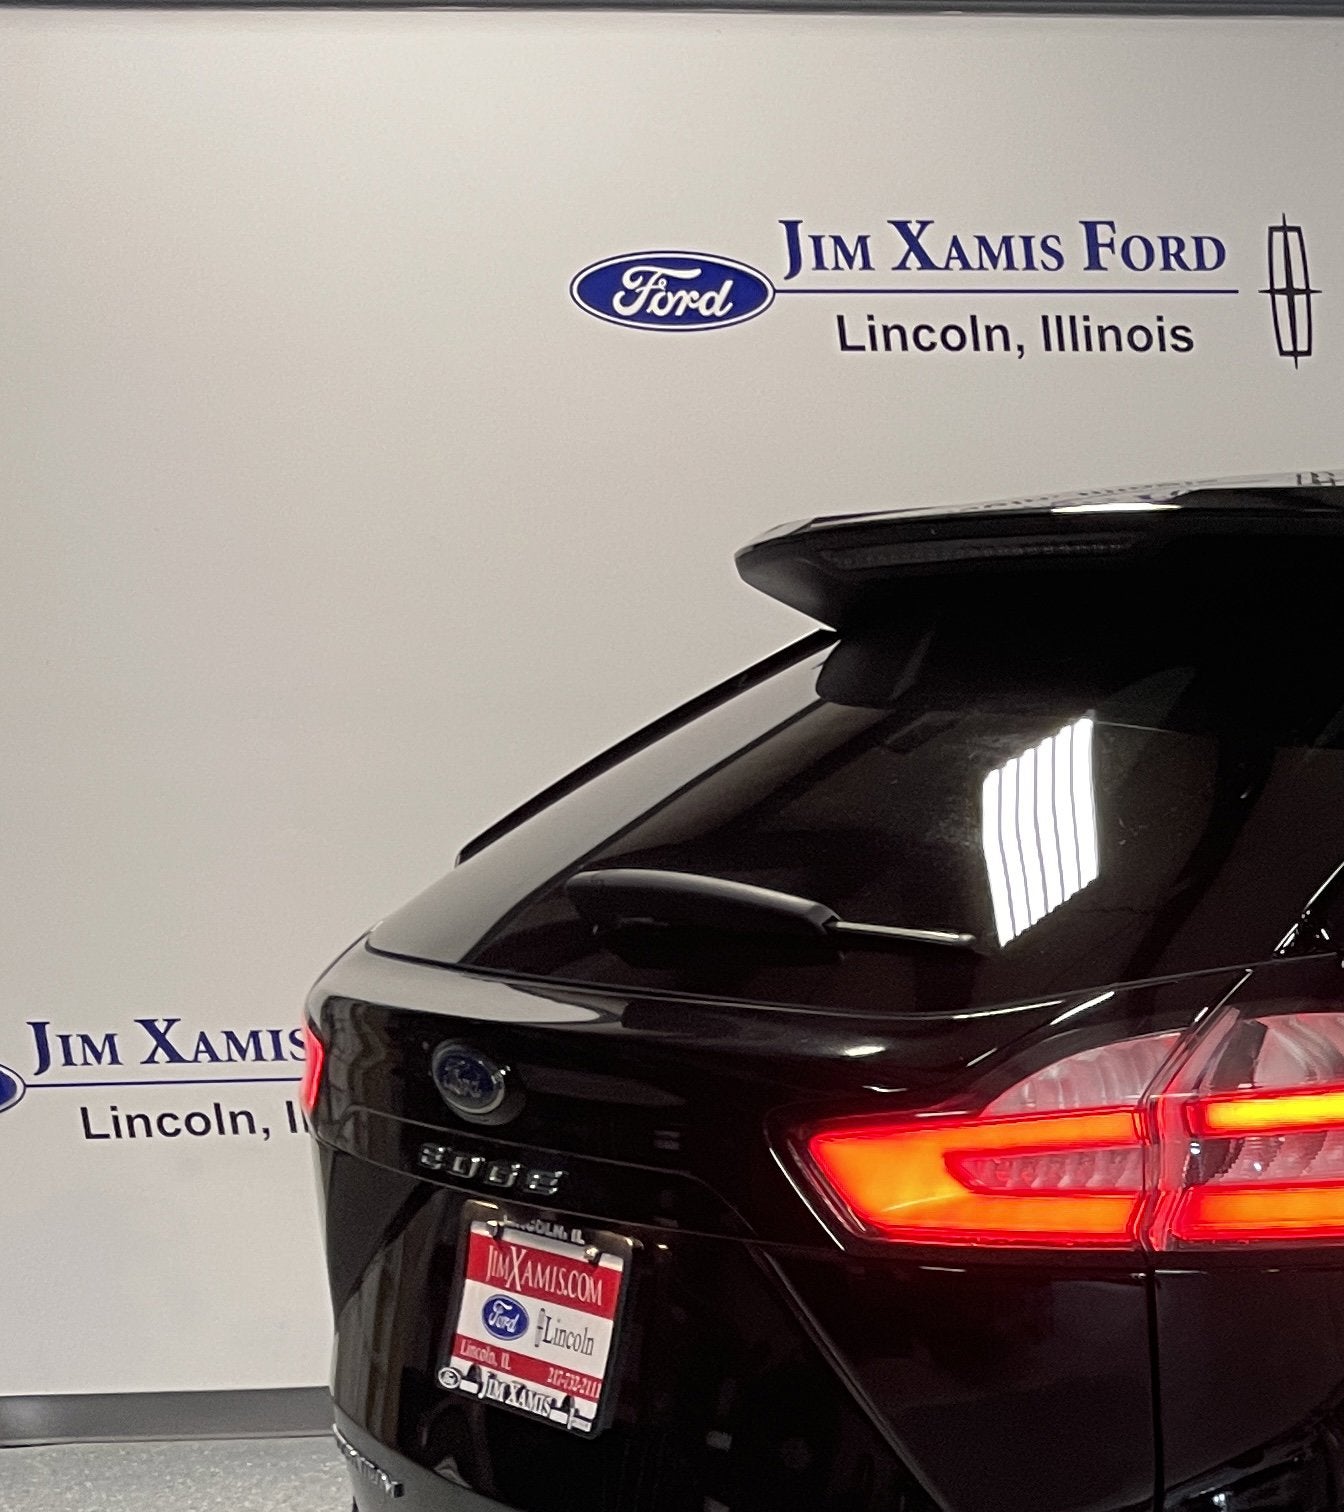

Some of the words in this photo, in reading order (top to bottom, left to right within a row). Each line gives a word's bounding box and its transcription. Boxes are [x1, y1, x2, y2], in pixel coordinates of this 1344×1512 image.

[778, 219, 873, 280] JIM
[887, 219, 1064, 271] XAMIS
[1079, 220, 1226, 271] FORD
[612, 266, 733, 317] Ford
[836, 313, 1025, 360] Lincoln,
[1042, 313, 1194, 353] Illinois
[26, 1021, 124, 1076] JIM
[80, 1102, 271, 1141] Lincoln,
[488, 1300, 522, 1333] Ford
[543, 1316, 594, 1356] Lincoln
